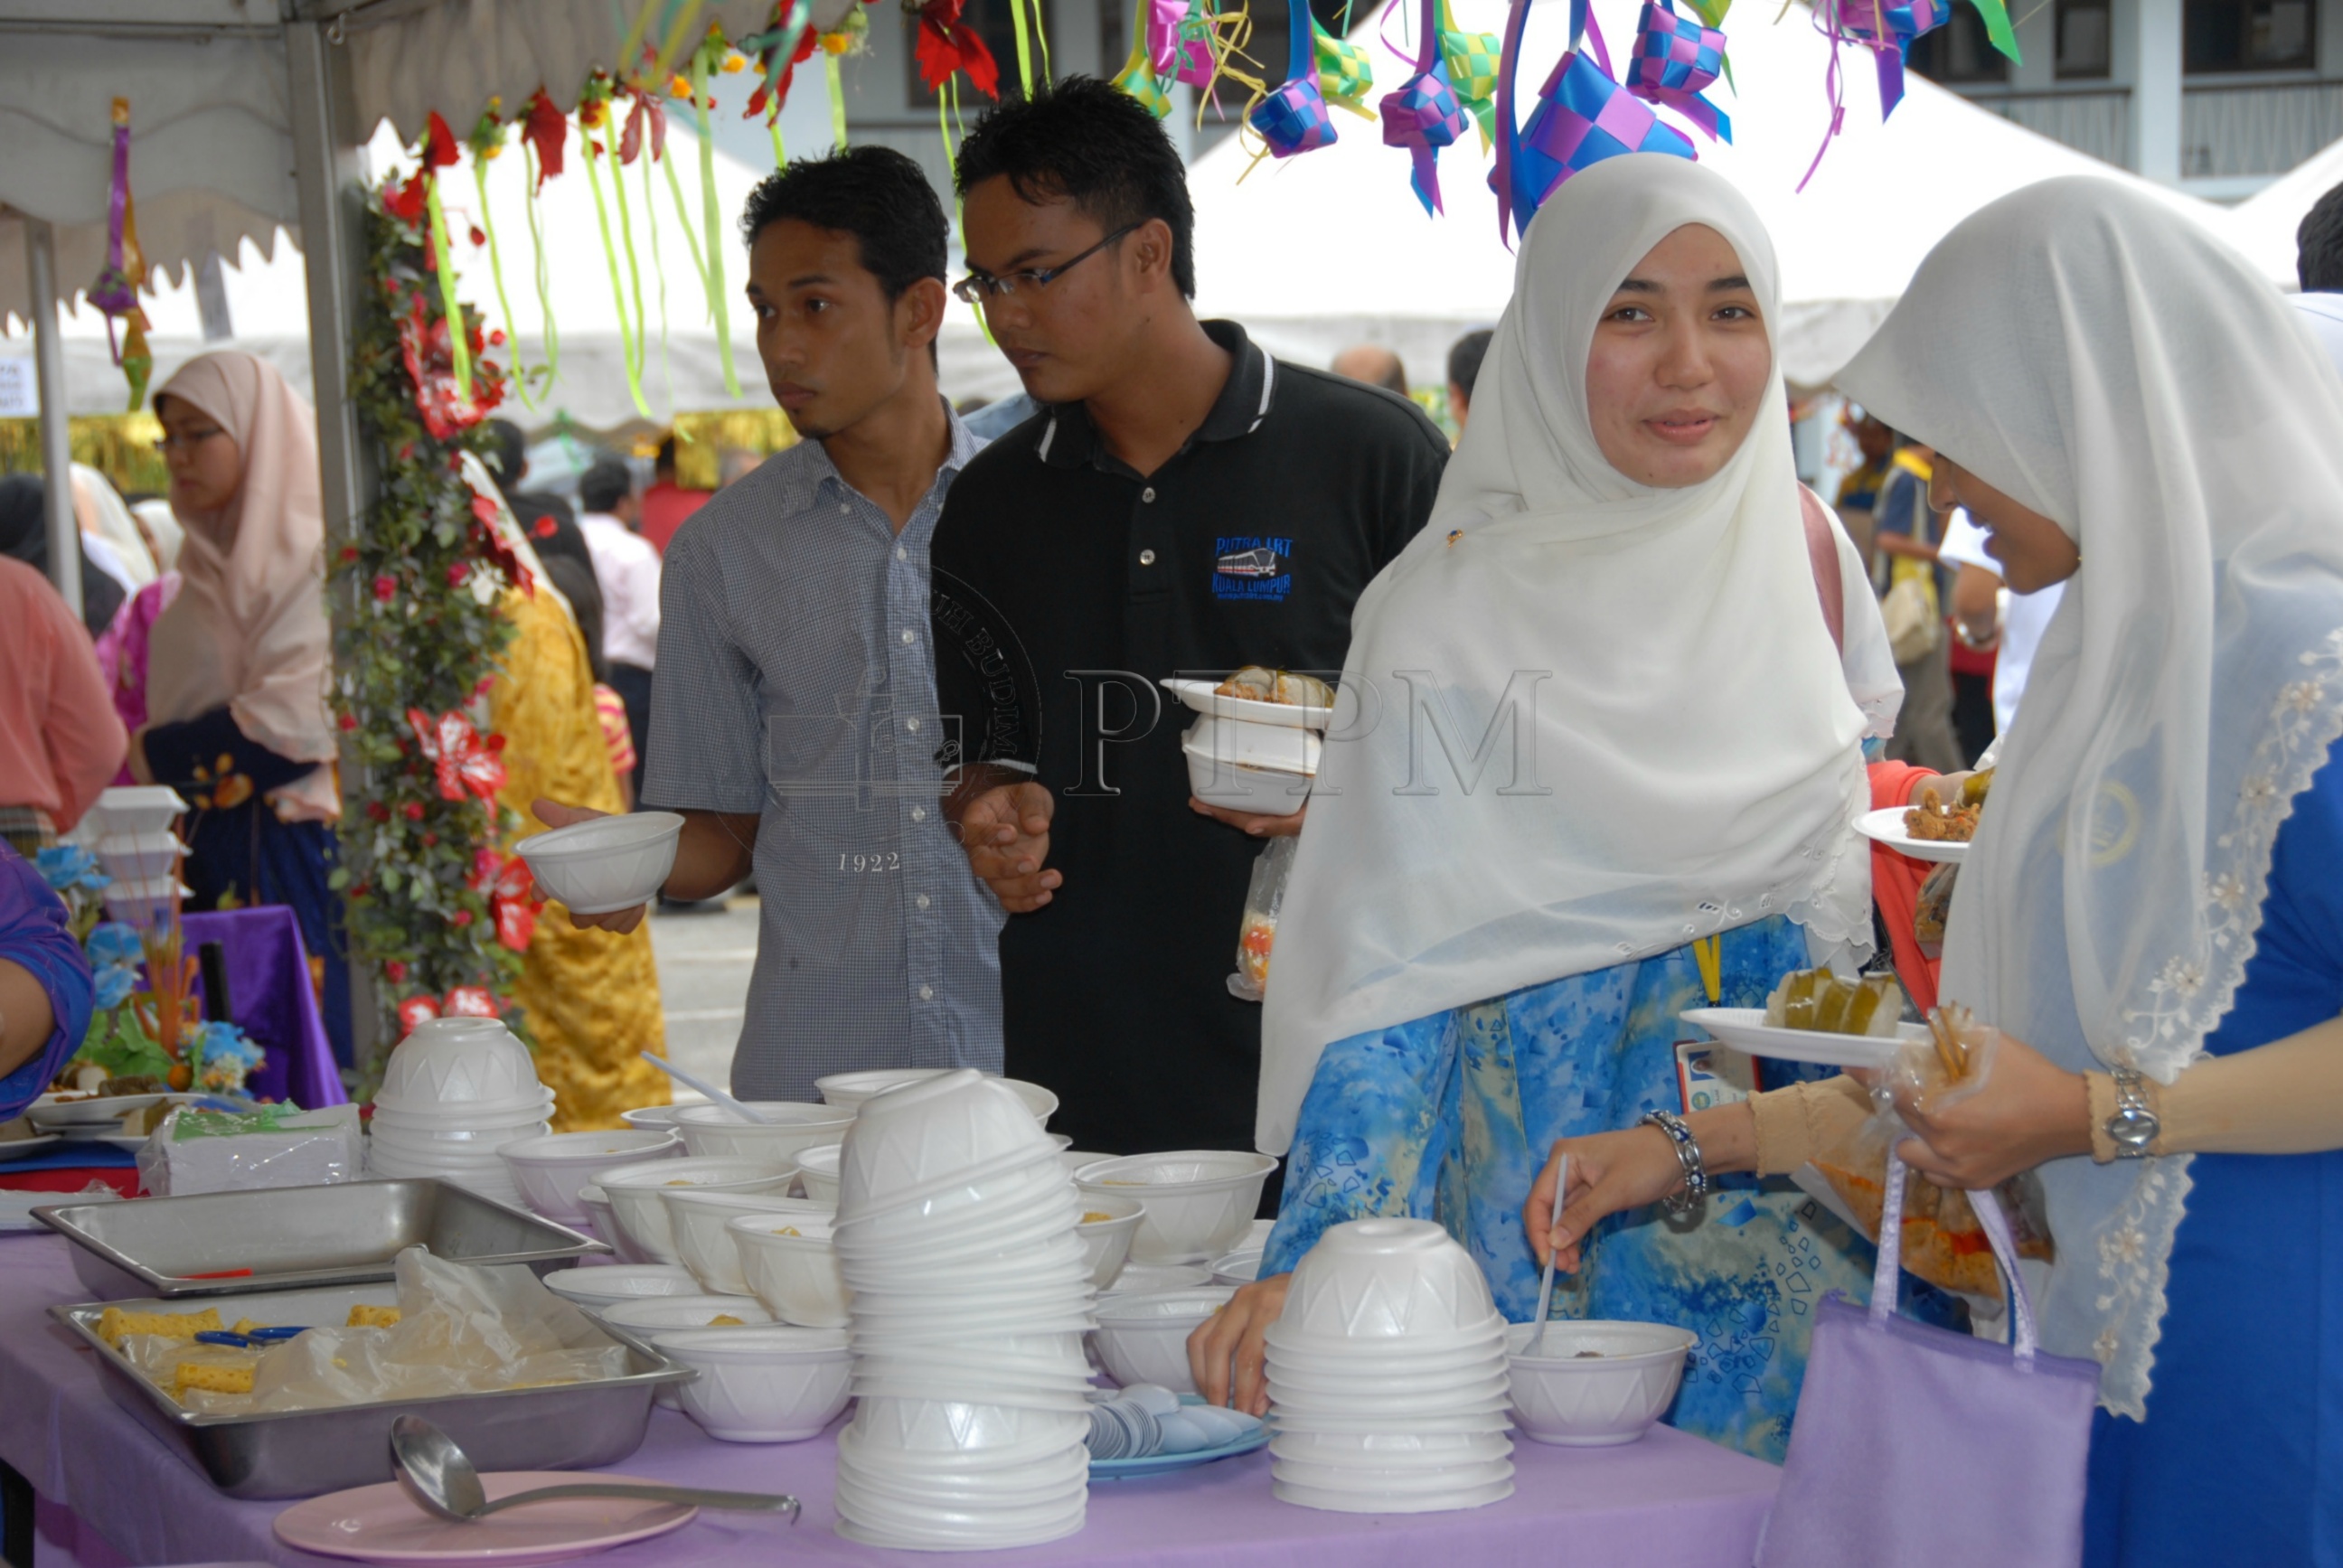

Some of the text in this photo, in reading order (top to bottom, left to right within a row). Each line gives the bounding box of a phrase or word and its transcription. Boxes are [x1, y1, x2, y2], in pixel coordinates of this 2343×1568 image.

[1215, 537, 1294, 558] PUTRA LRT
[1211, 573, 1291, 594] KUALA LUMPUR
